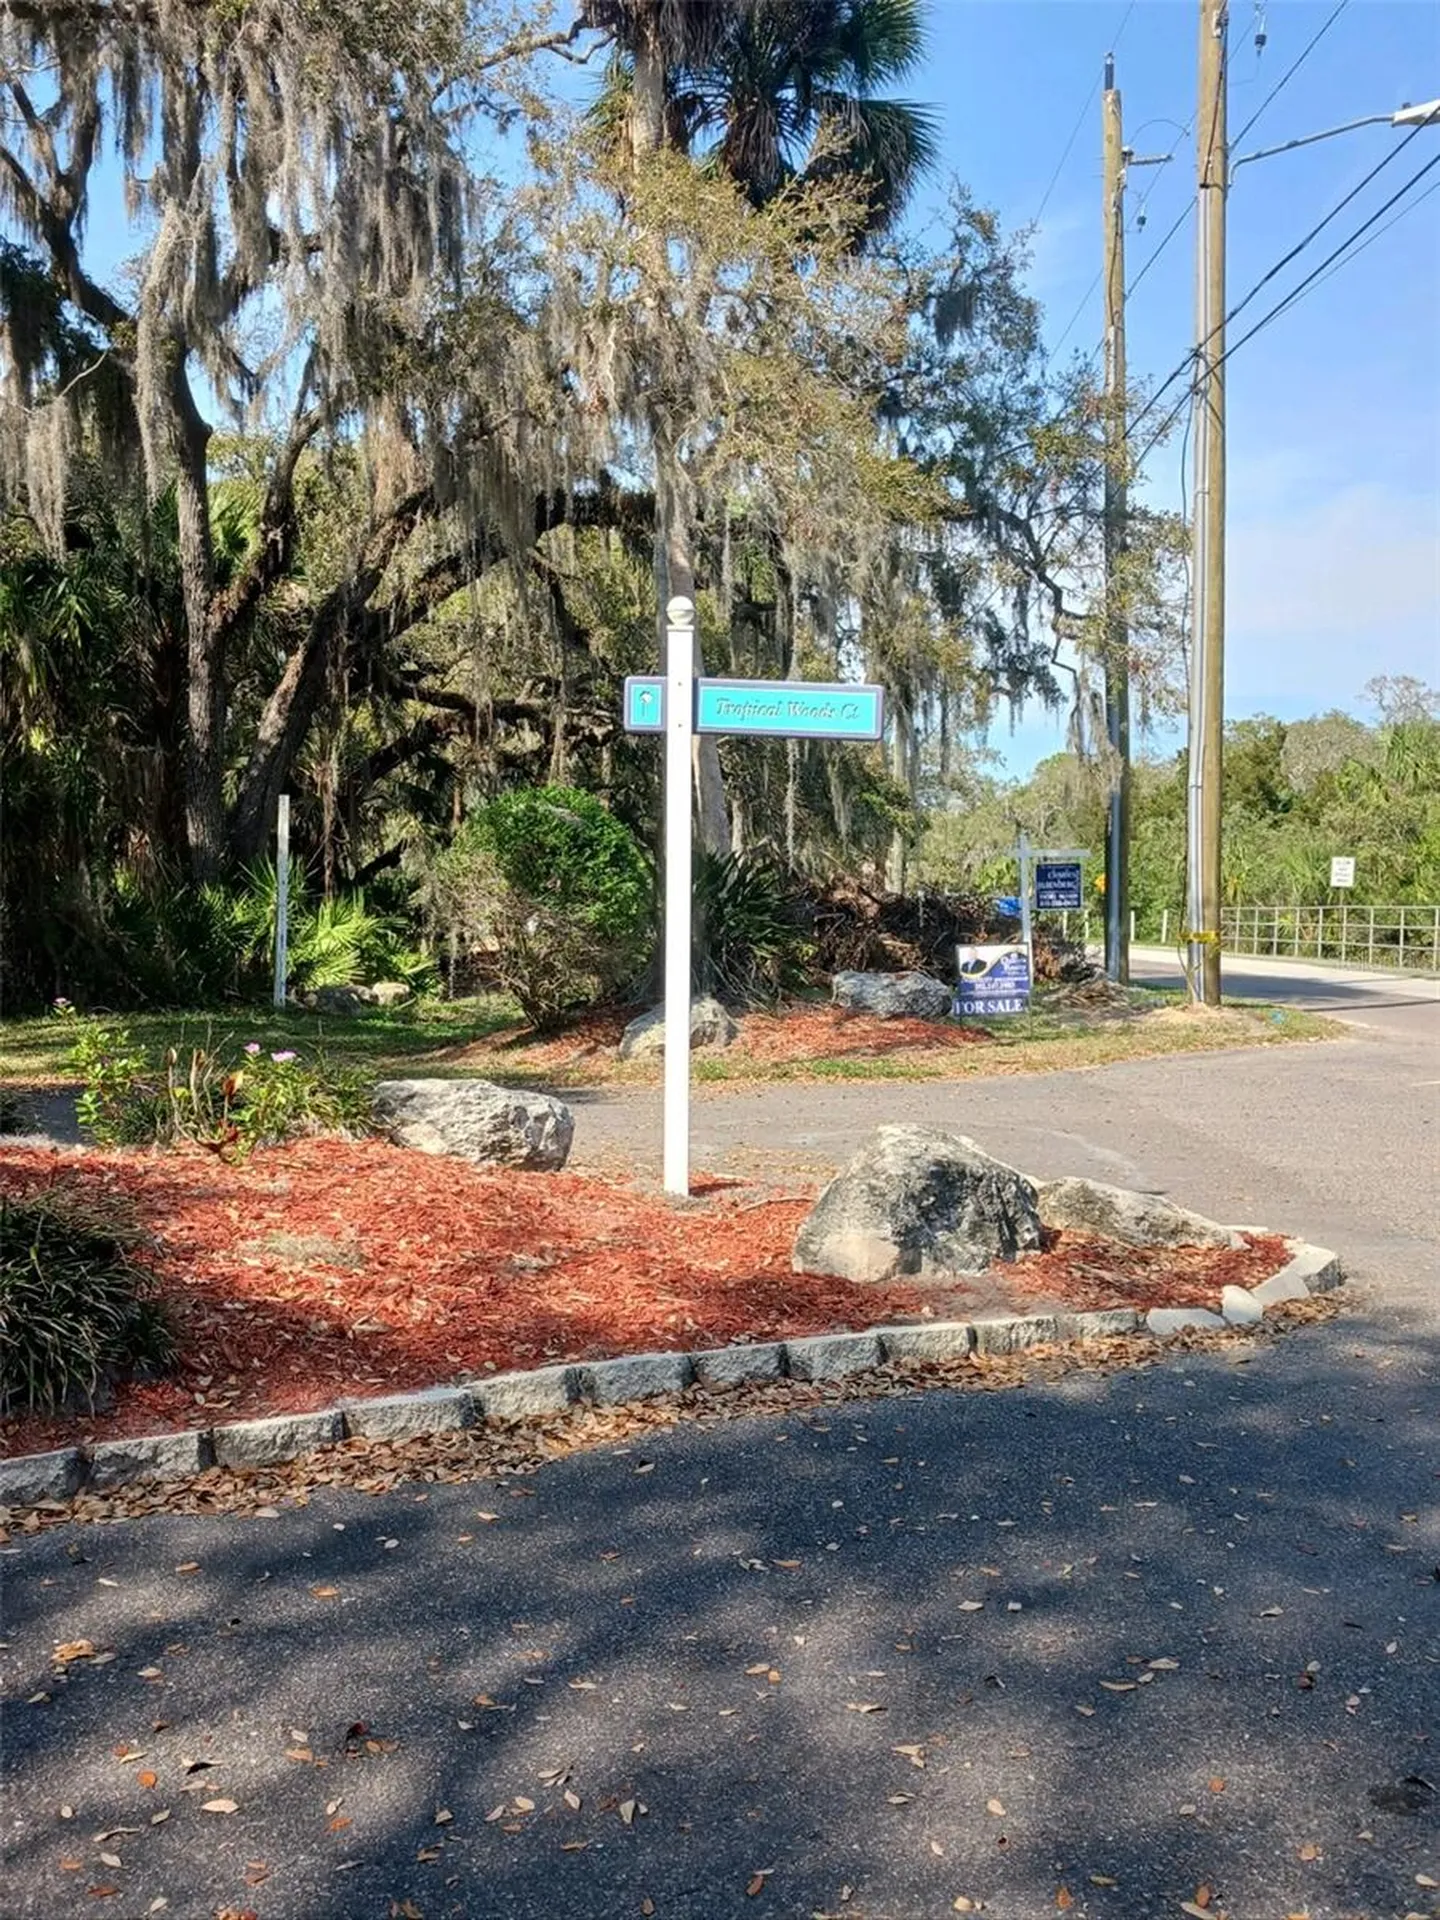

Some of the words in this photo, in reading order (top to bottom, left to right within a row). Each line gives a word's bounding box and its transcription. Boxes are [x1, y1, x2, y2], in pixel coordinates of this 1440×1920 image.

[716, 697, 783, 721] Tropical
[787, 700, 836, 719] Woods
[987, 999, 1024, 1014] SALE
